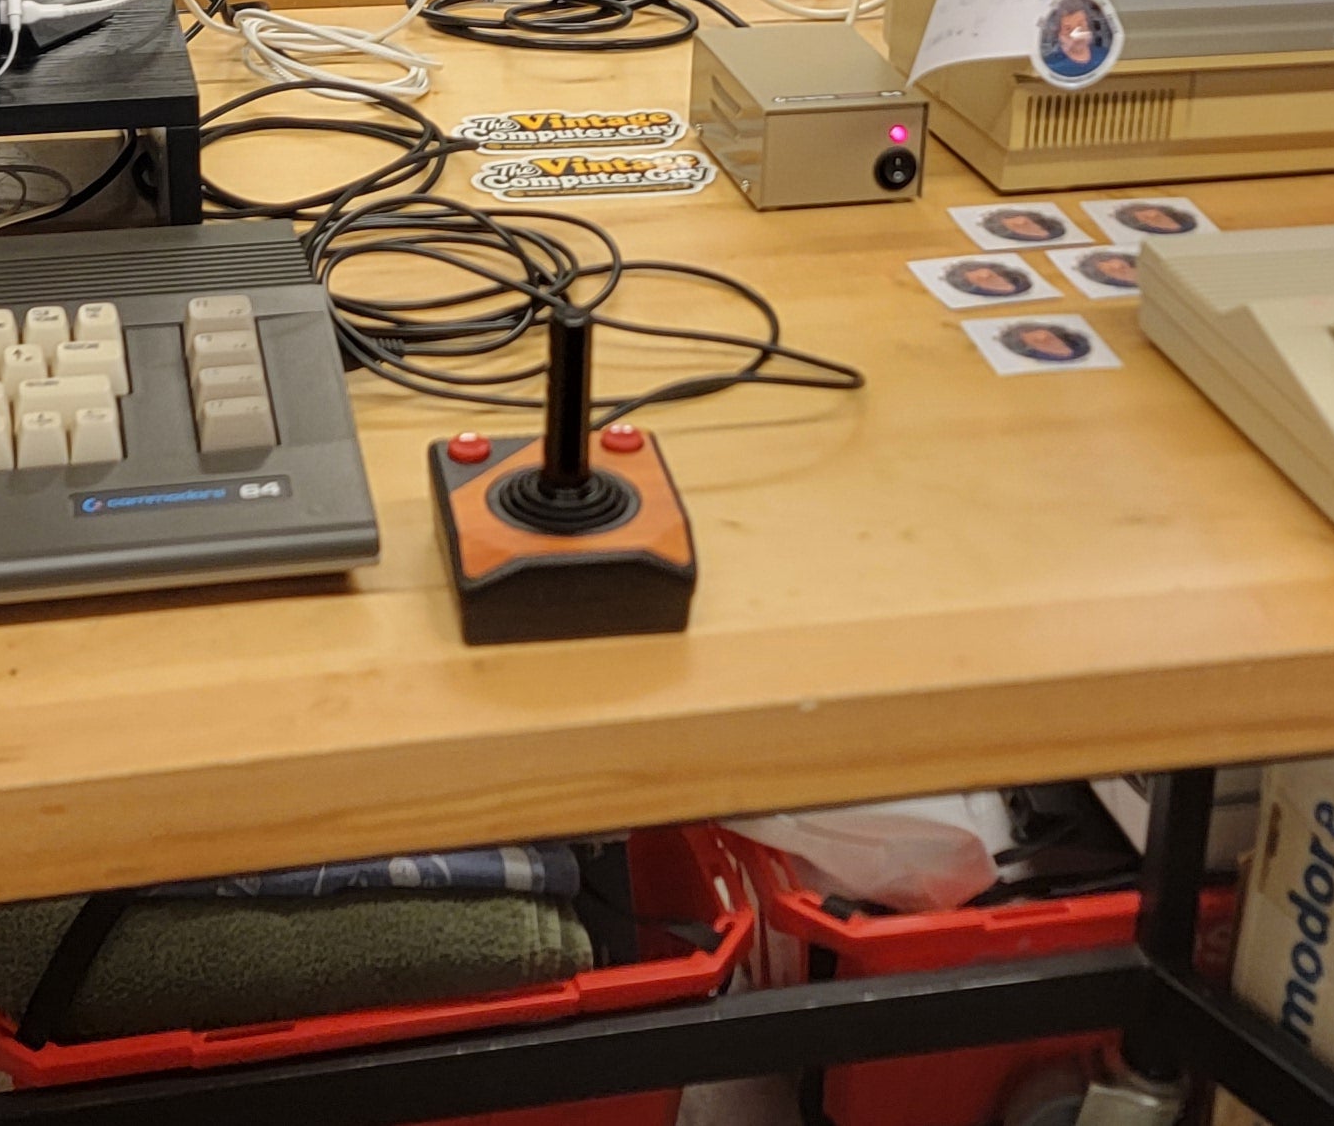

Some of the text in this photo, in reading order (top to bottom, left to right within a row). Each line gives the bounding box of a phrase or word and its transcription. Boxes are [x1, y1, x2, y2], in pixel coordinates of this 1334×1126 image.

[476, 112, 672, 131] The Vintage
[464, 123, 681, 143] Computer Guy
[494, 155, 698, 177] The Vintage
[483, 171, 643, 190] Computer
[643, 165, 706, 183] Guy
[106, 480, 281, 509] commodore 64
